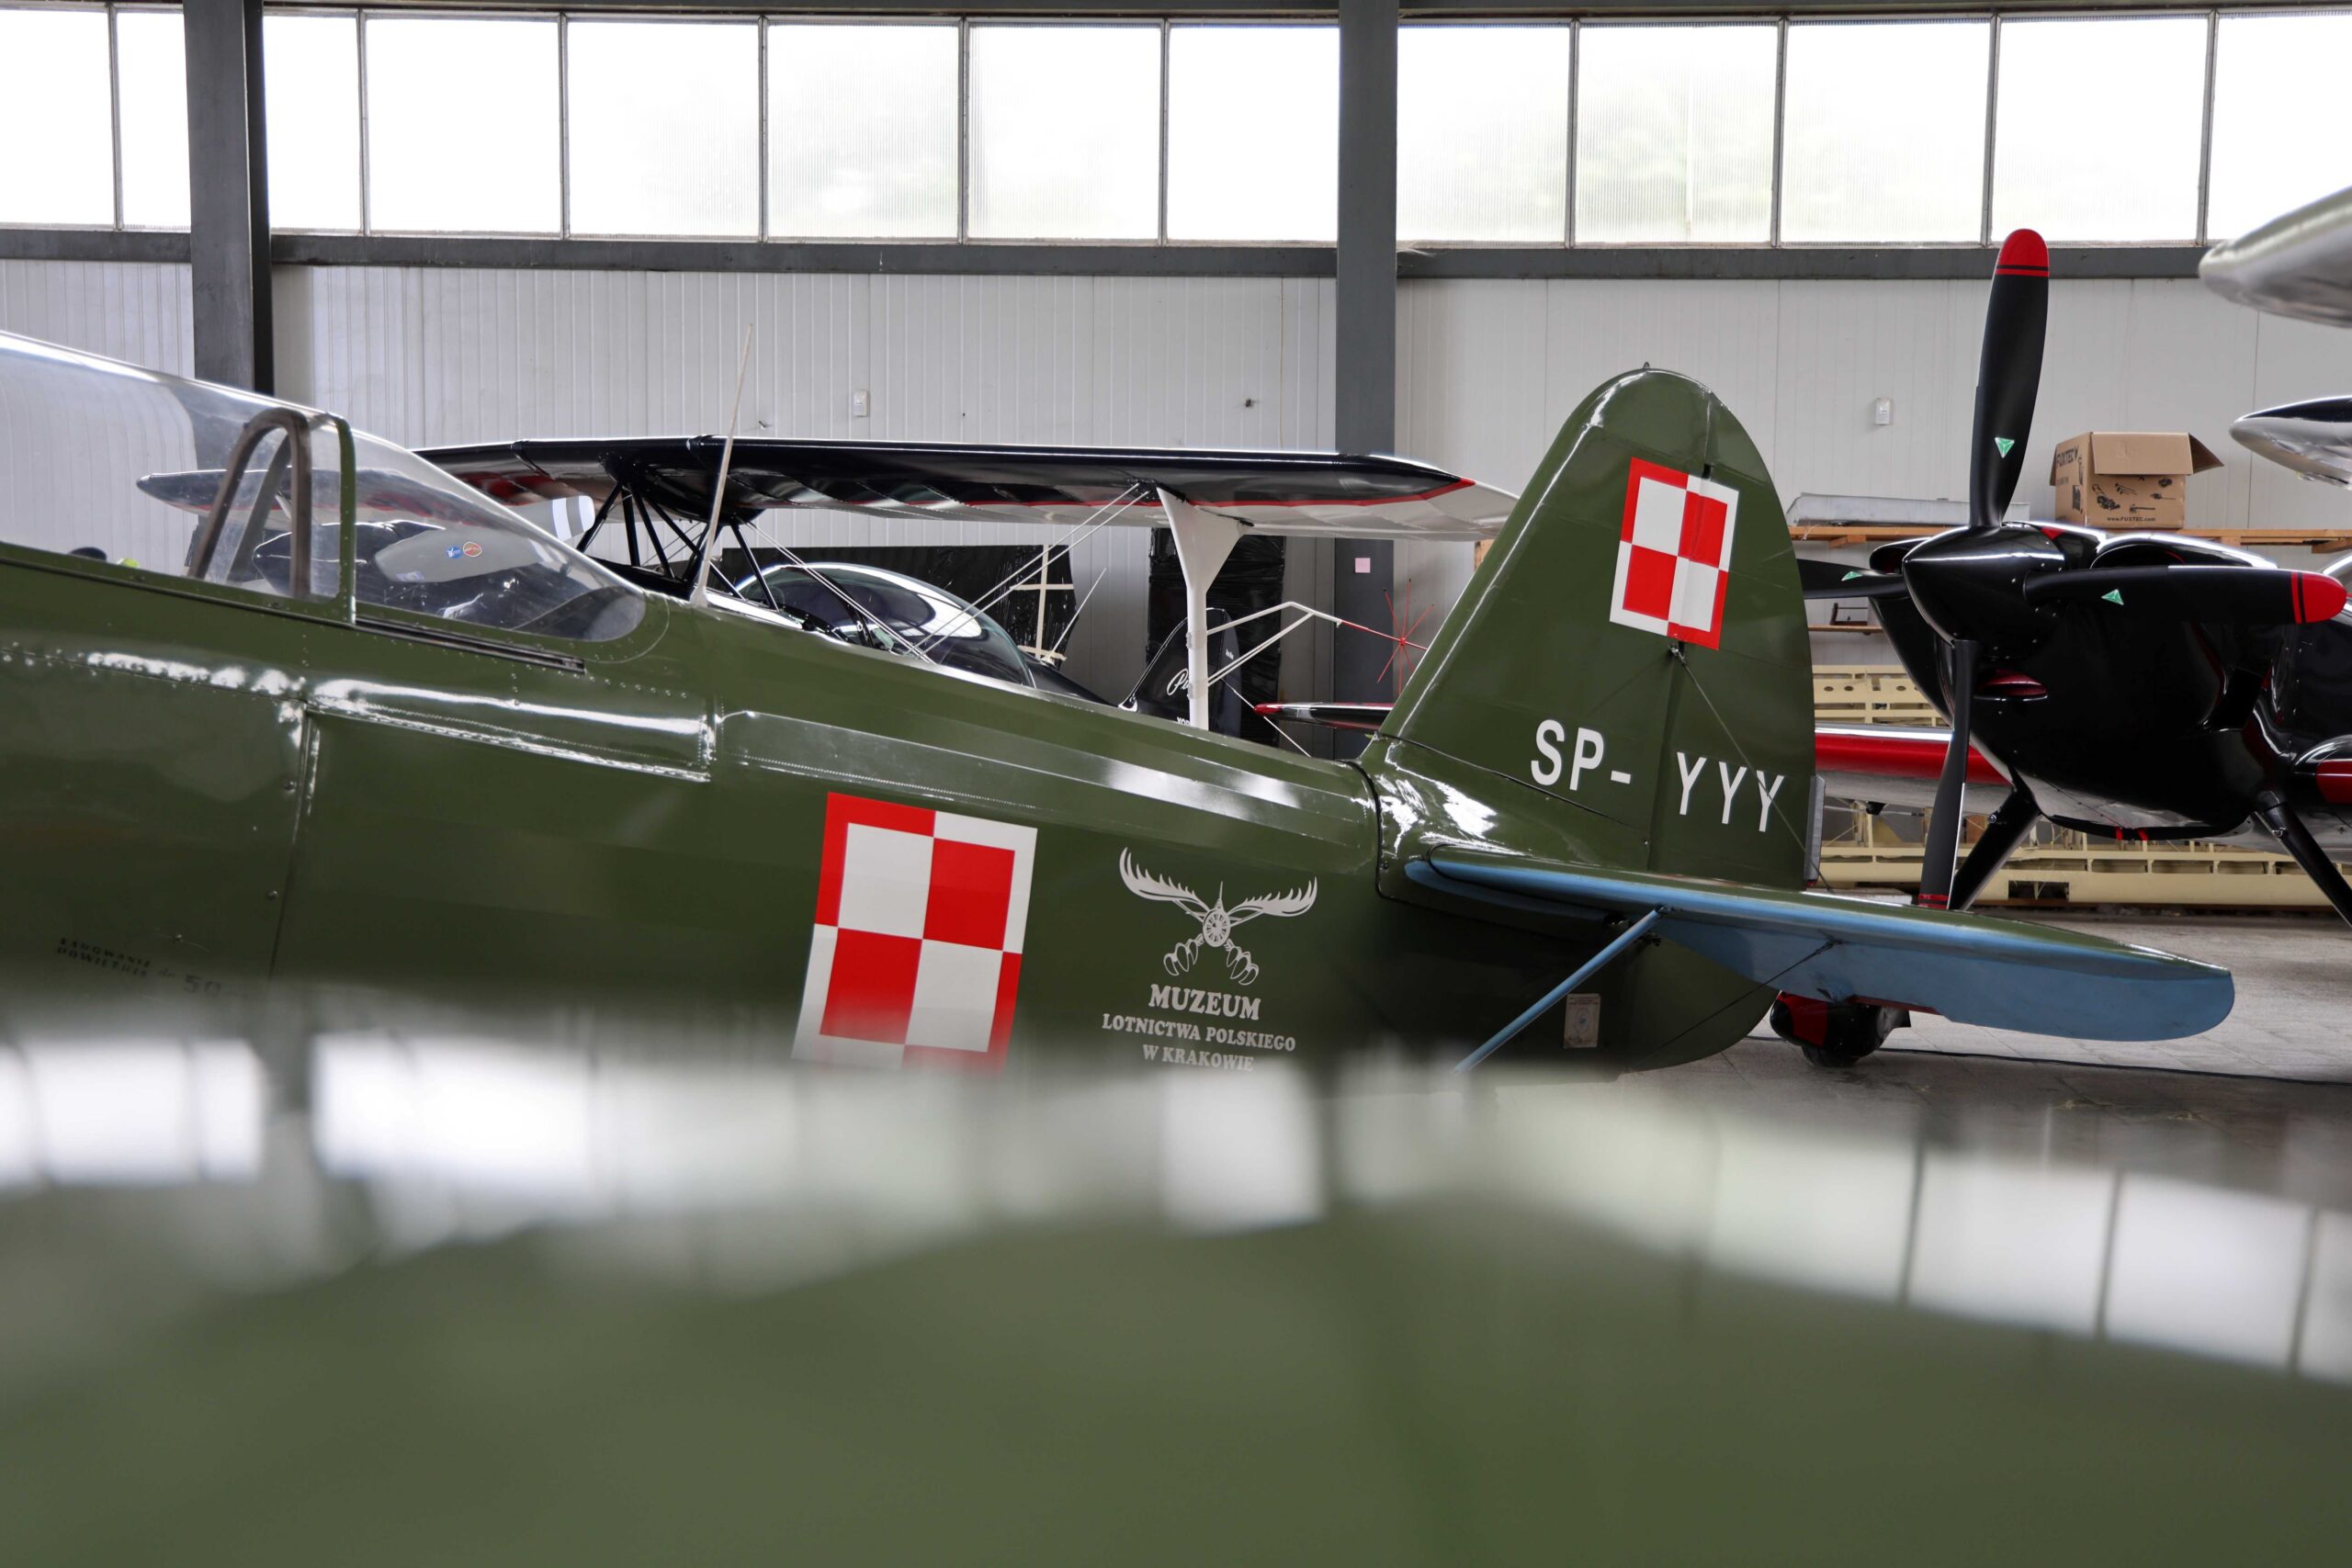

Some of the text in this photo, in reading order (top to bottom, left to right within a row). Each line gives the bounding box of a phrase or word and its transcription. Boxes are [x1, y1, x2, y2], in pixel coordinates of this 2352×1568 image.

[1531, 718, 1785, 833] SP- YYY
[1148, 983, 1261, 1021] MUZEUM
[1102, 1012, 1296, 1052] LOTNICTWA POLSKIEGO
[1142, 1043, 1255, 1072] W KRAKOWIE
